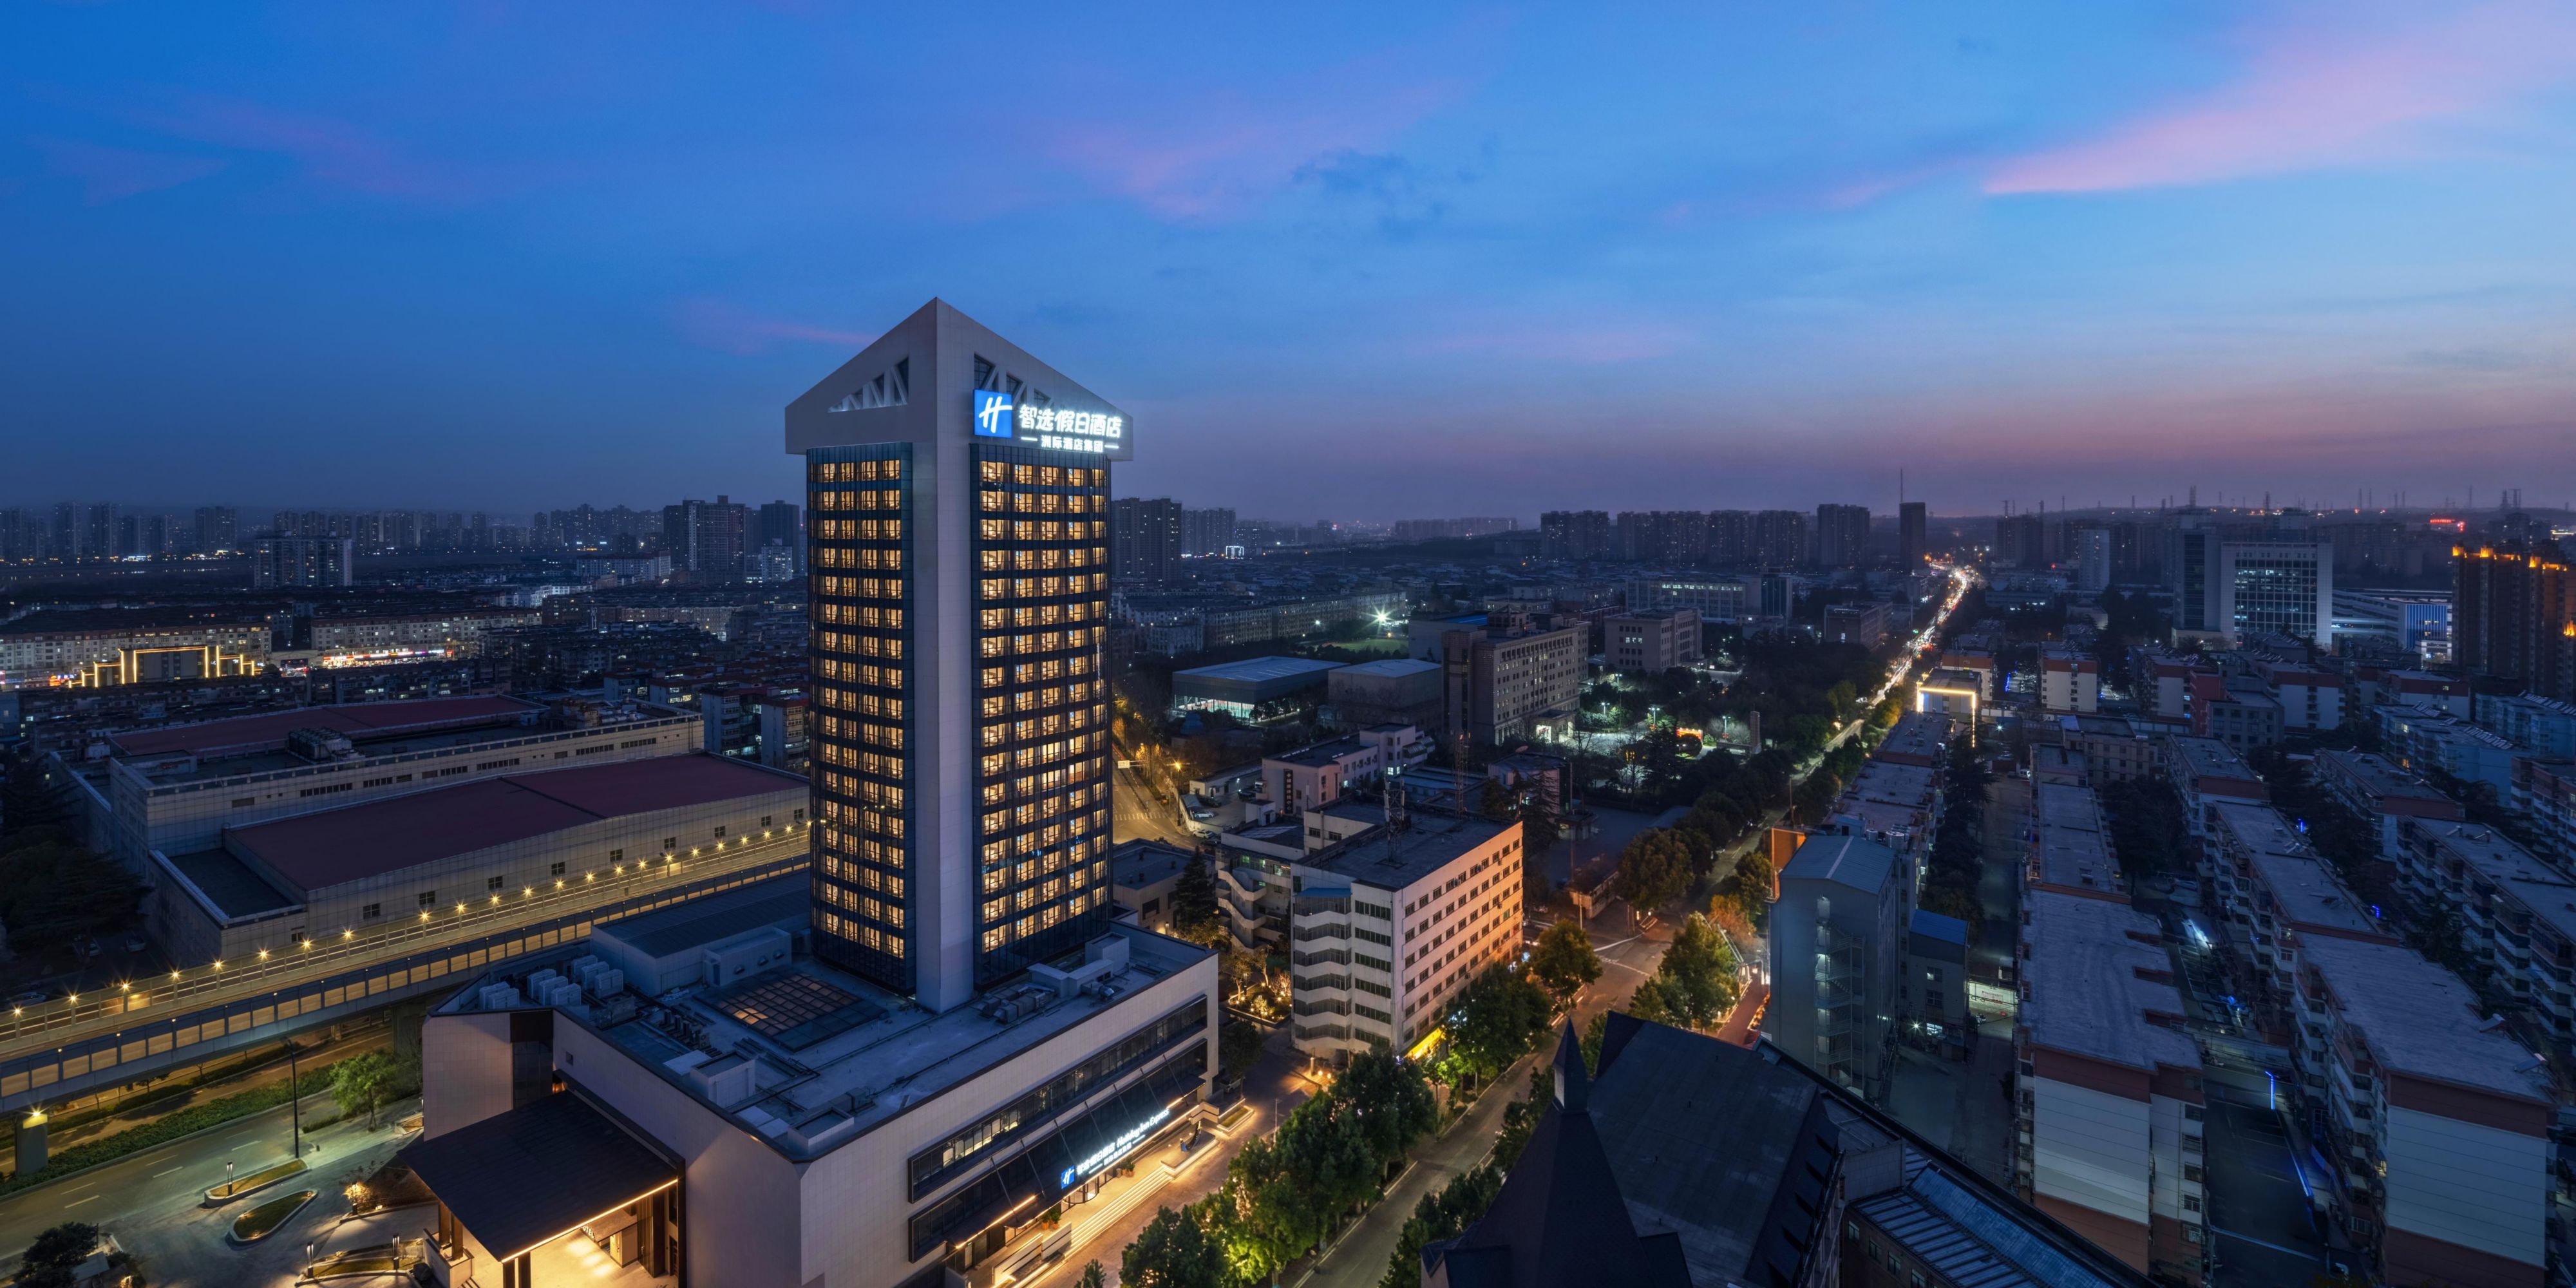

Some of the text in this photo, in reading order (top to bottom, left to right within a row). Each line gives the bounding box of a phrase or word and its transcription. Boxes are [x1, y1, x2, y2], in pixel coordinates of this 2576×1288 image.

[1019, 404, 1122, 438] 智选假日酒店
[1041, 435, 1104, 453] 洲际酒店集团
[1140, 1122, 1150, 1133] Inn
